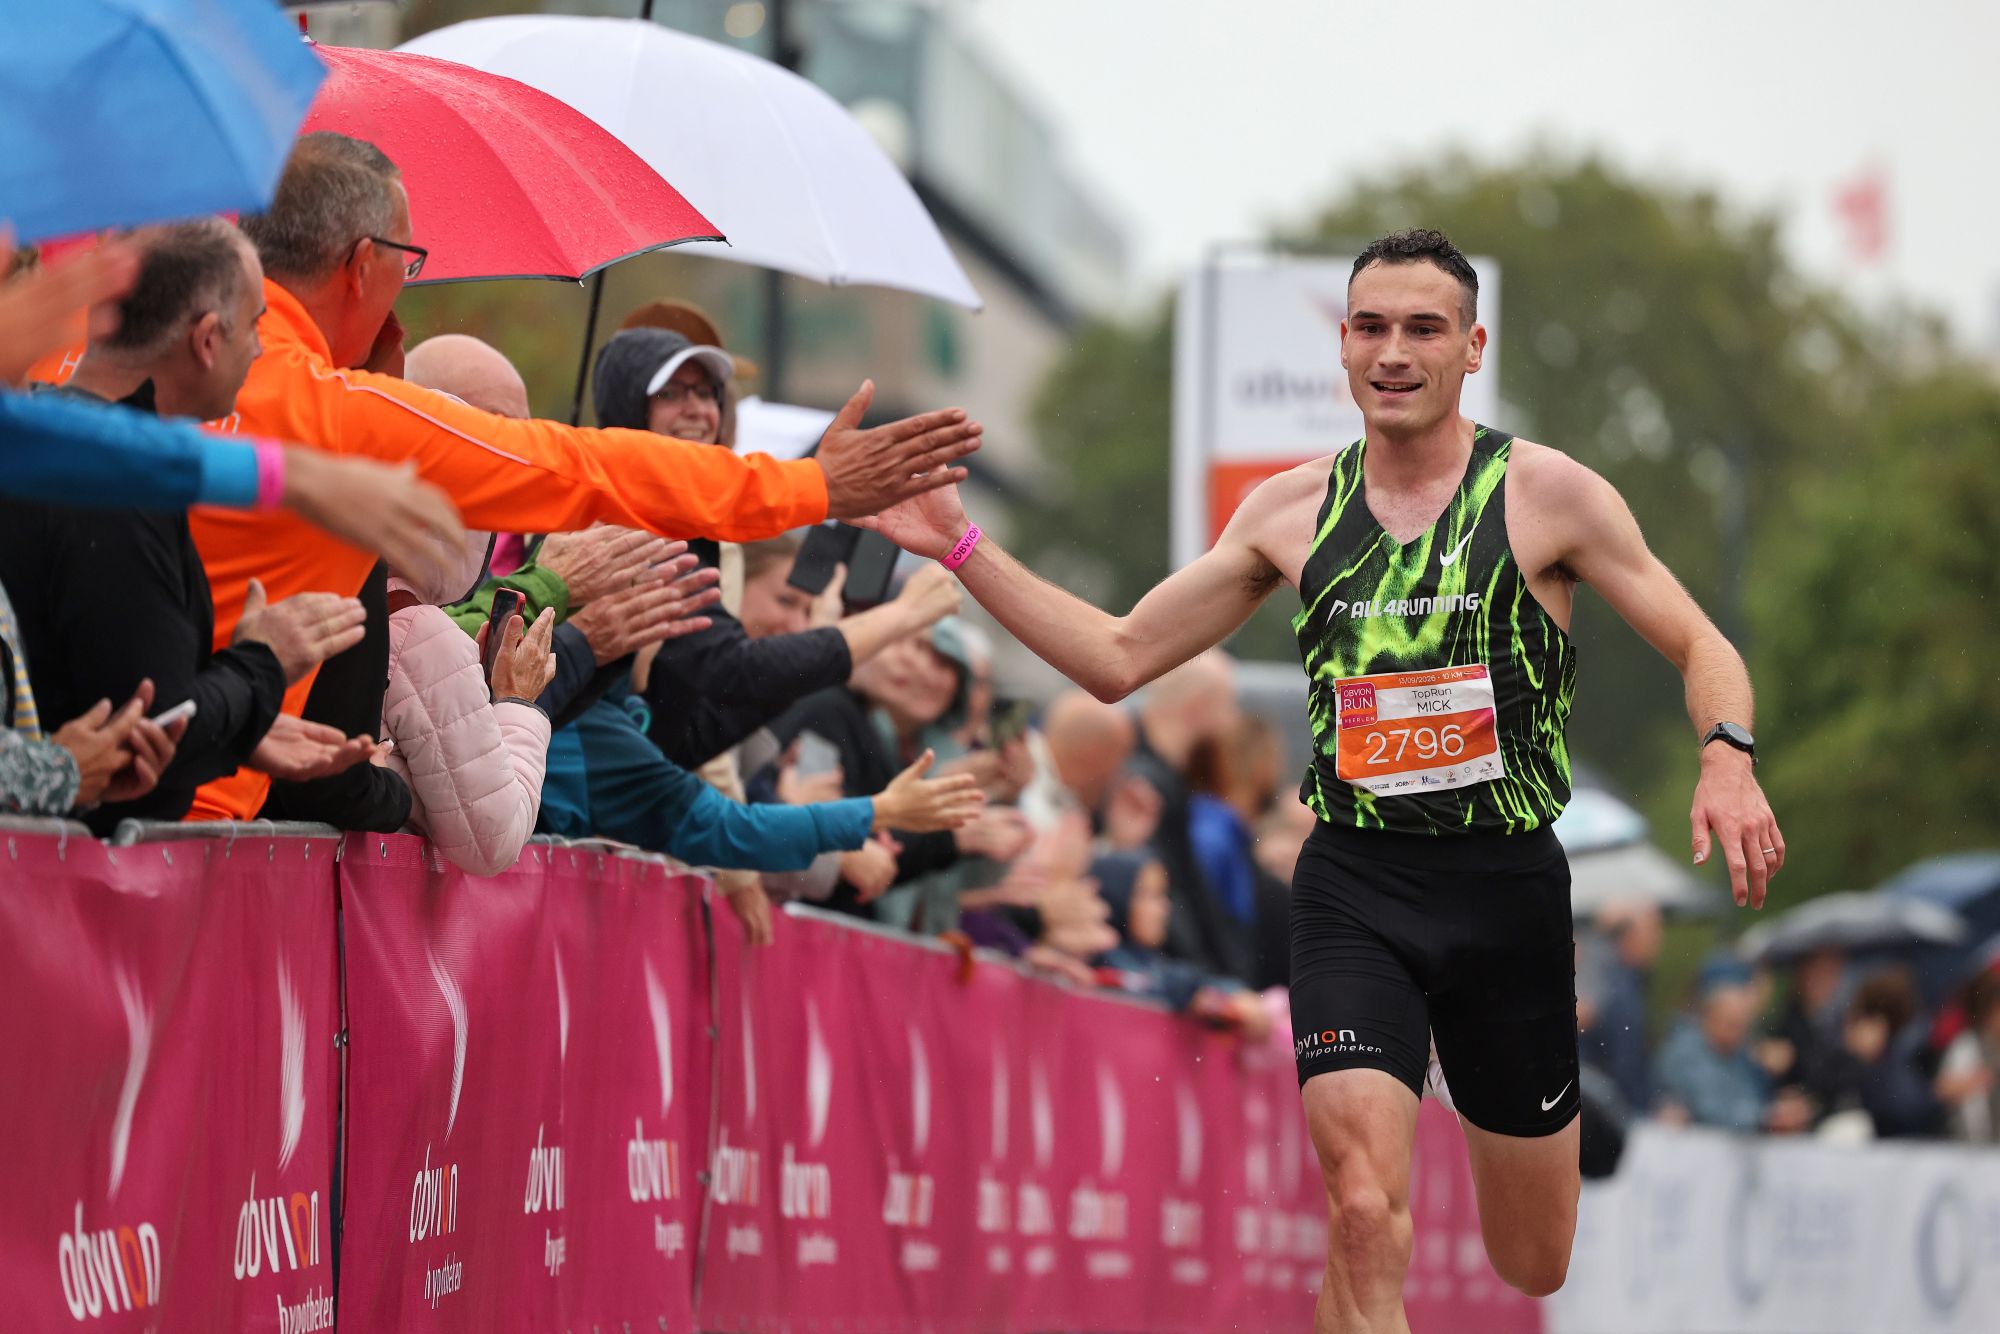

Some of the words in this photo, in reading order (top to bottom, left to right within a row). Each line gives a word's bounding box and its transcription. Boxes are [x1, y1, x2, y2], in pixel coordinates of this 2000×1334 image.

[1351, 592, 1479, 619] ALL4RUNNING
[1451, 671, 1463, 679] KM
[1344, 688, 1372, 698] OBVION
[1412, 688, 1452, 699] TopRun
[1343, 696, 1373, 711] RUN
[1417, 699, 1452, 713] MICK
[1365, 724, 1465, 765] 2796
[1305, 1043, 1382, 1060] hypotheken
[409, 1142, 458, 1244] obvion
[233, 1171, 320, 1280] obvion
[58, 1199, 161, 1321] obvion
